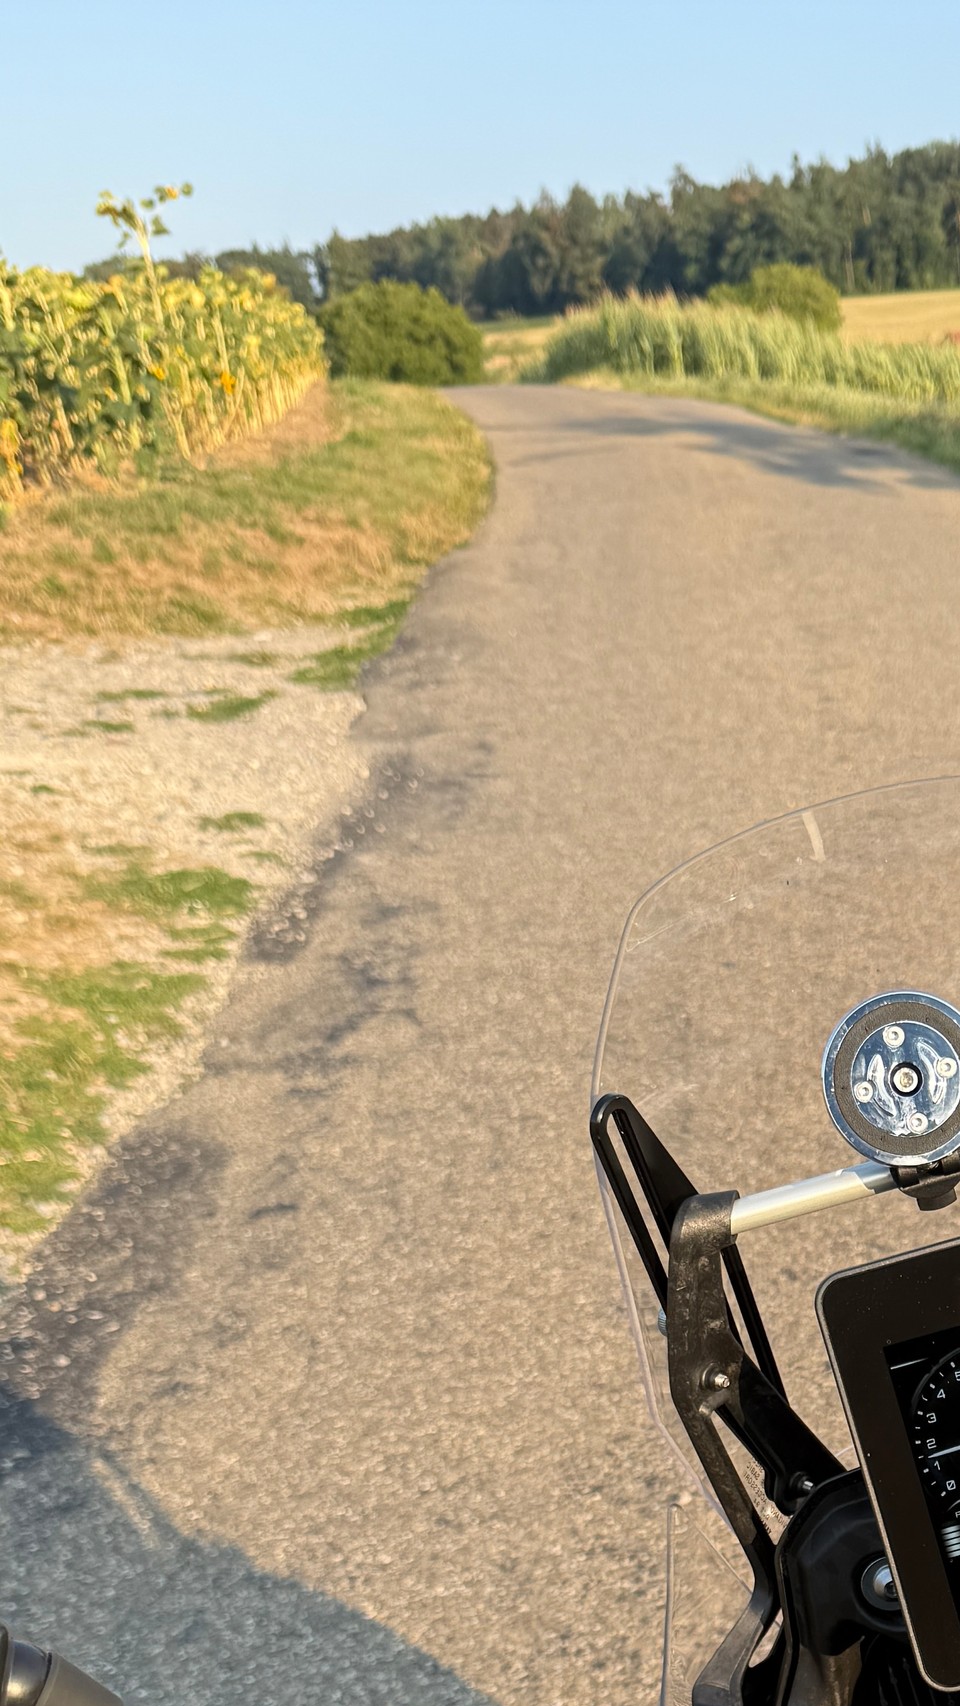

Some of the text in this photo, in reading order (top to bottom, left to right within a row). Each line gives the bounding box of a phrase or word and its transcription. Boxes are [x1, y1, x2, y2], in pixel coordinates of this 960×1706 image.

[937, 1388, 946, 1400] 4
[926, 1413, 937, 1424] 3
[926, 1438, 937, 1449] 2
[933, 1460, 941, 1471] 1
[946, 1479, 957, 1491] 0
